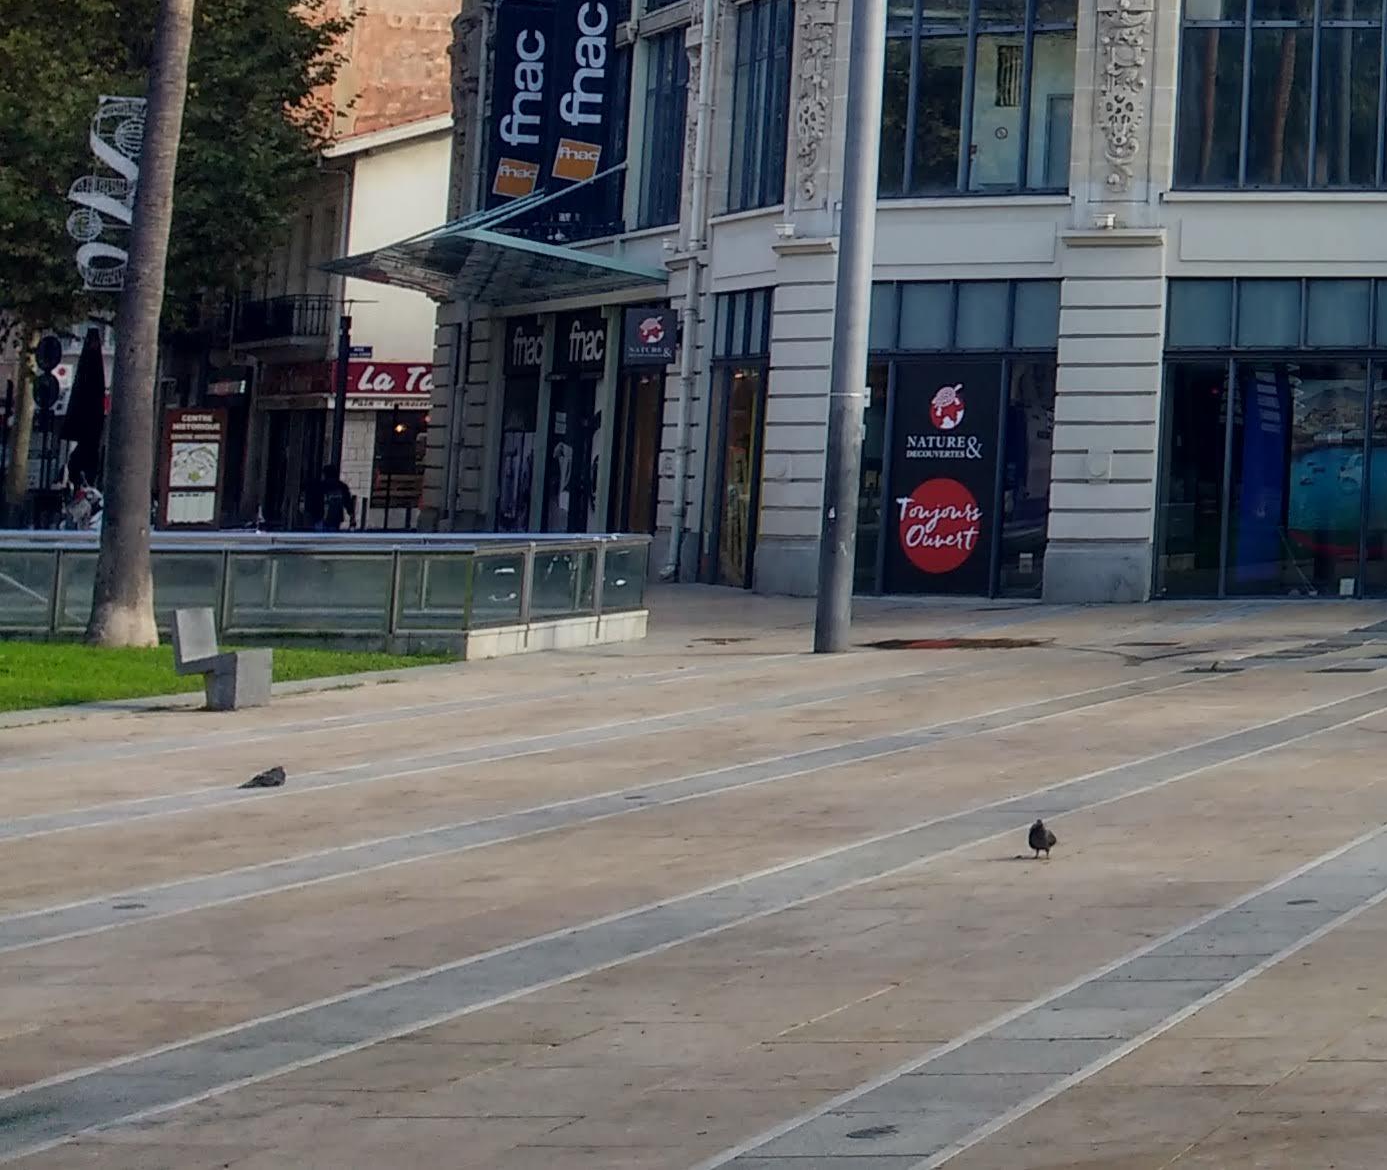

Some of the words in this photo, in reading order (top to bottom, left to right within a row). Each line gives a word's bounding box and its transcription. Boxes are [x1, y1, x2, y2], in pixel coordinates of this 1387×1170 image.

[559, 1, 609, 127] fnac
[499, 28, 546, 146] fnac
[559, 146, 600, 161] fnac
[499, 164, 538, 179] fnac
[512, 325, 544, 366] fnac
[568, 320, 605, 362] fnac
[357, 365, 396, 391] La
[172, 422, 221, 431] HISTORIQUE
[180, 414, 214, 423] CENTRE
[905, 435, 966, 449] NATURE
[966, 436, 984, 459] &
[905, 449, 967, 459] DECOUVERTES
[896, 496, 984, 534] Toujours
[905, 526, 981, 551] Ouvert
